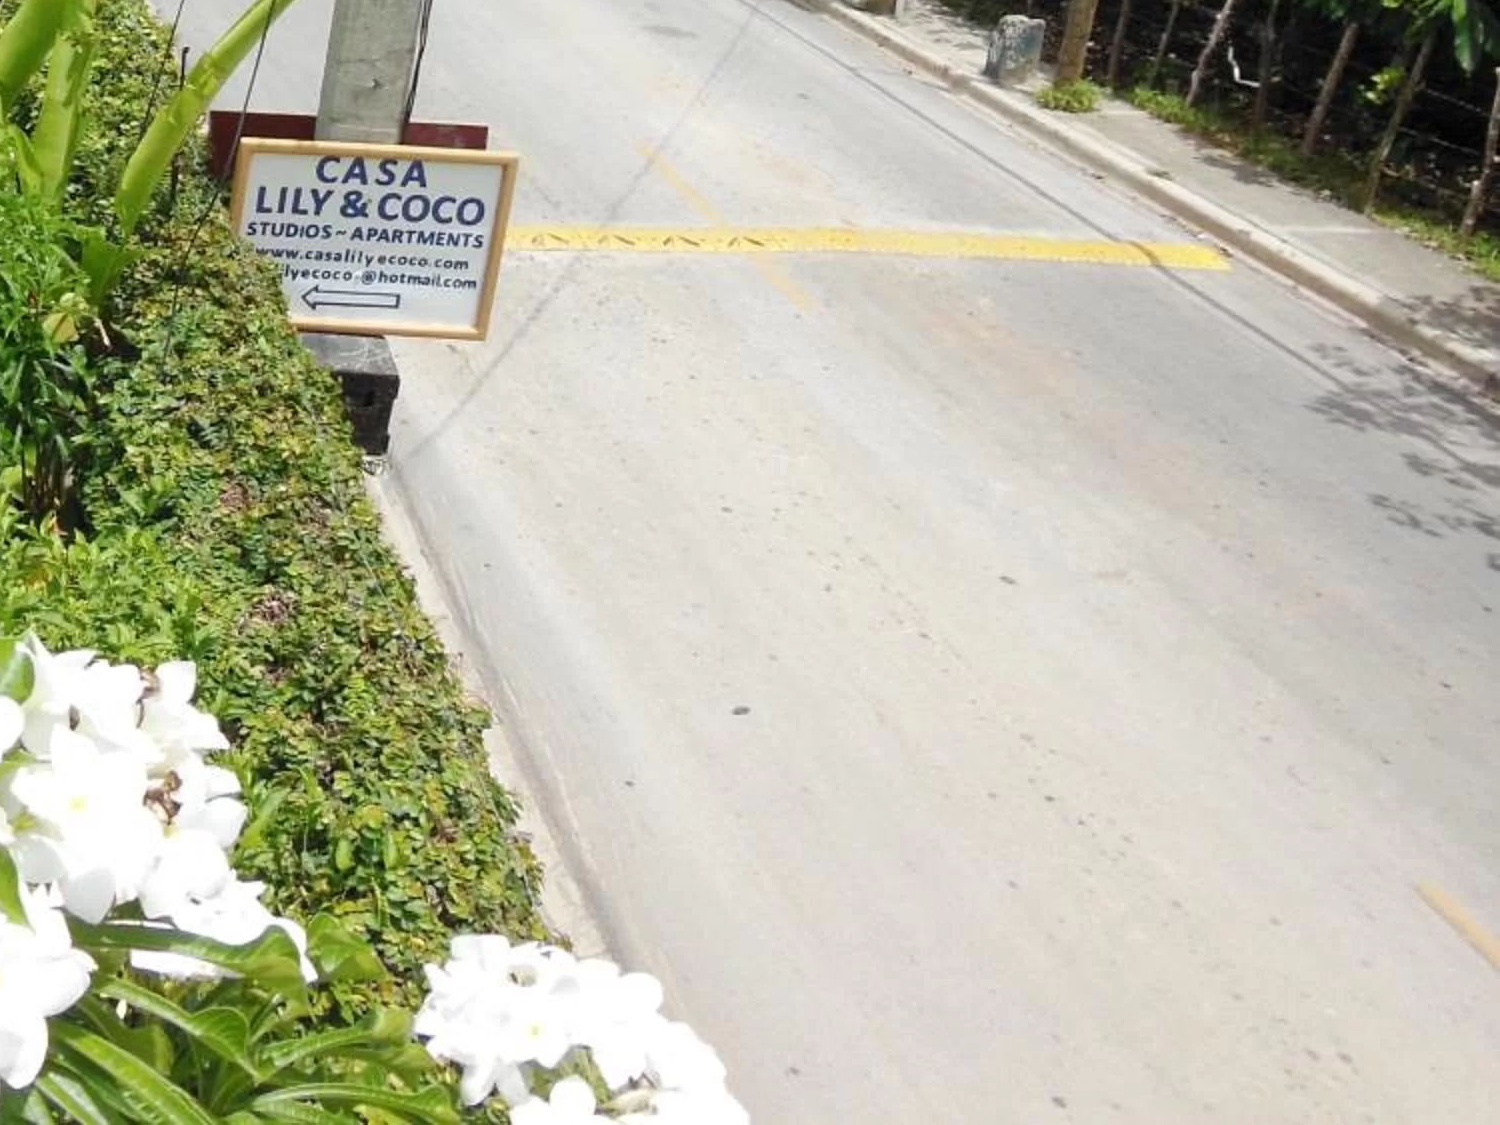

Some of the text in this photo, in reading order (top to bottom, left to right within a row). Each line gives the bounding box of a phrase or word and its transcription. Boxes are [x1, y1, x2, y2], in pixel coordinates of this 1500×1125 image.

[315, 155, 428, 188] CASA
[254, 185, 486, 226] LILY & COCO
[246, 221, 333, 240] STUDIOS
[350, 225, 485, 249] APARTMENTS
